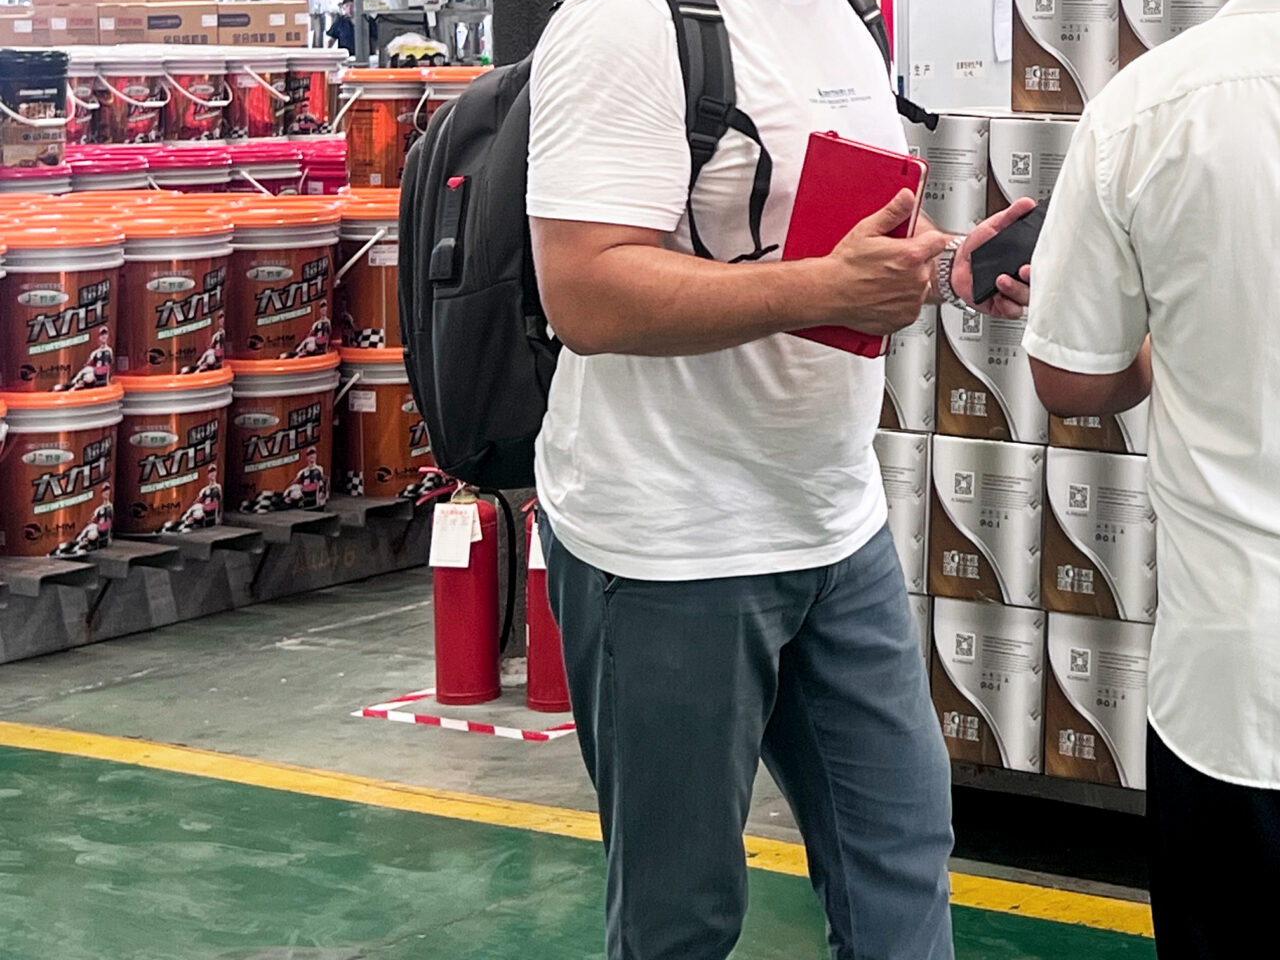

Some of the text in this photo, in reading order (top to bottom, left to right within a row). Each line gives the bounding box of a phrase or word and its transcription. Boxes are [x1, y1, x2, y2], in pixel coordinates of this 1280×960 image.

[156, 286, 224, 328] 大力士
[256, 276, 328, 315] 大力士
[26, 300, 109, 342] 大力士
[139, 440, 218, 483] 大力士
[243, 423, 320, 461] 大力士
[32, 457, 112, 501] 大力士
